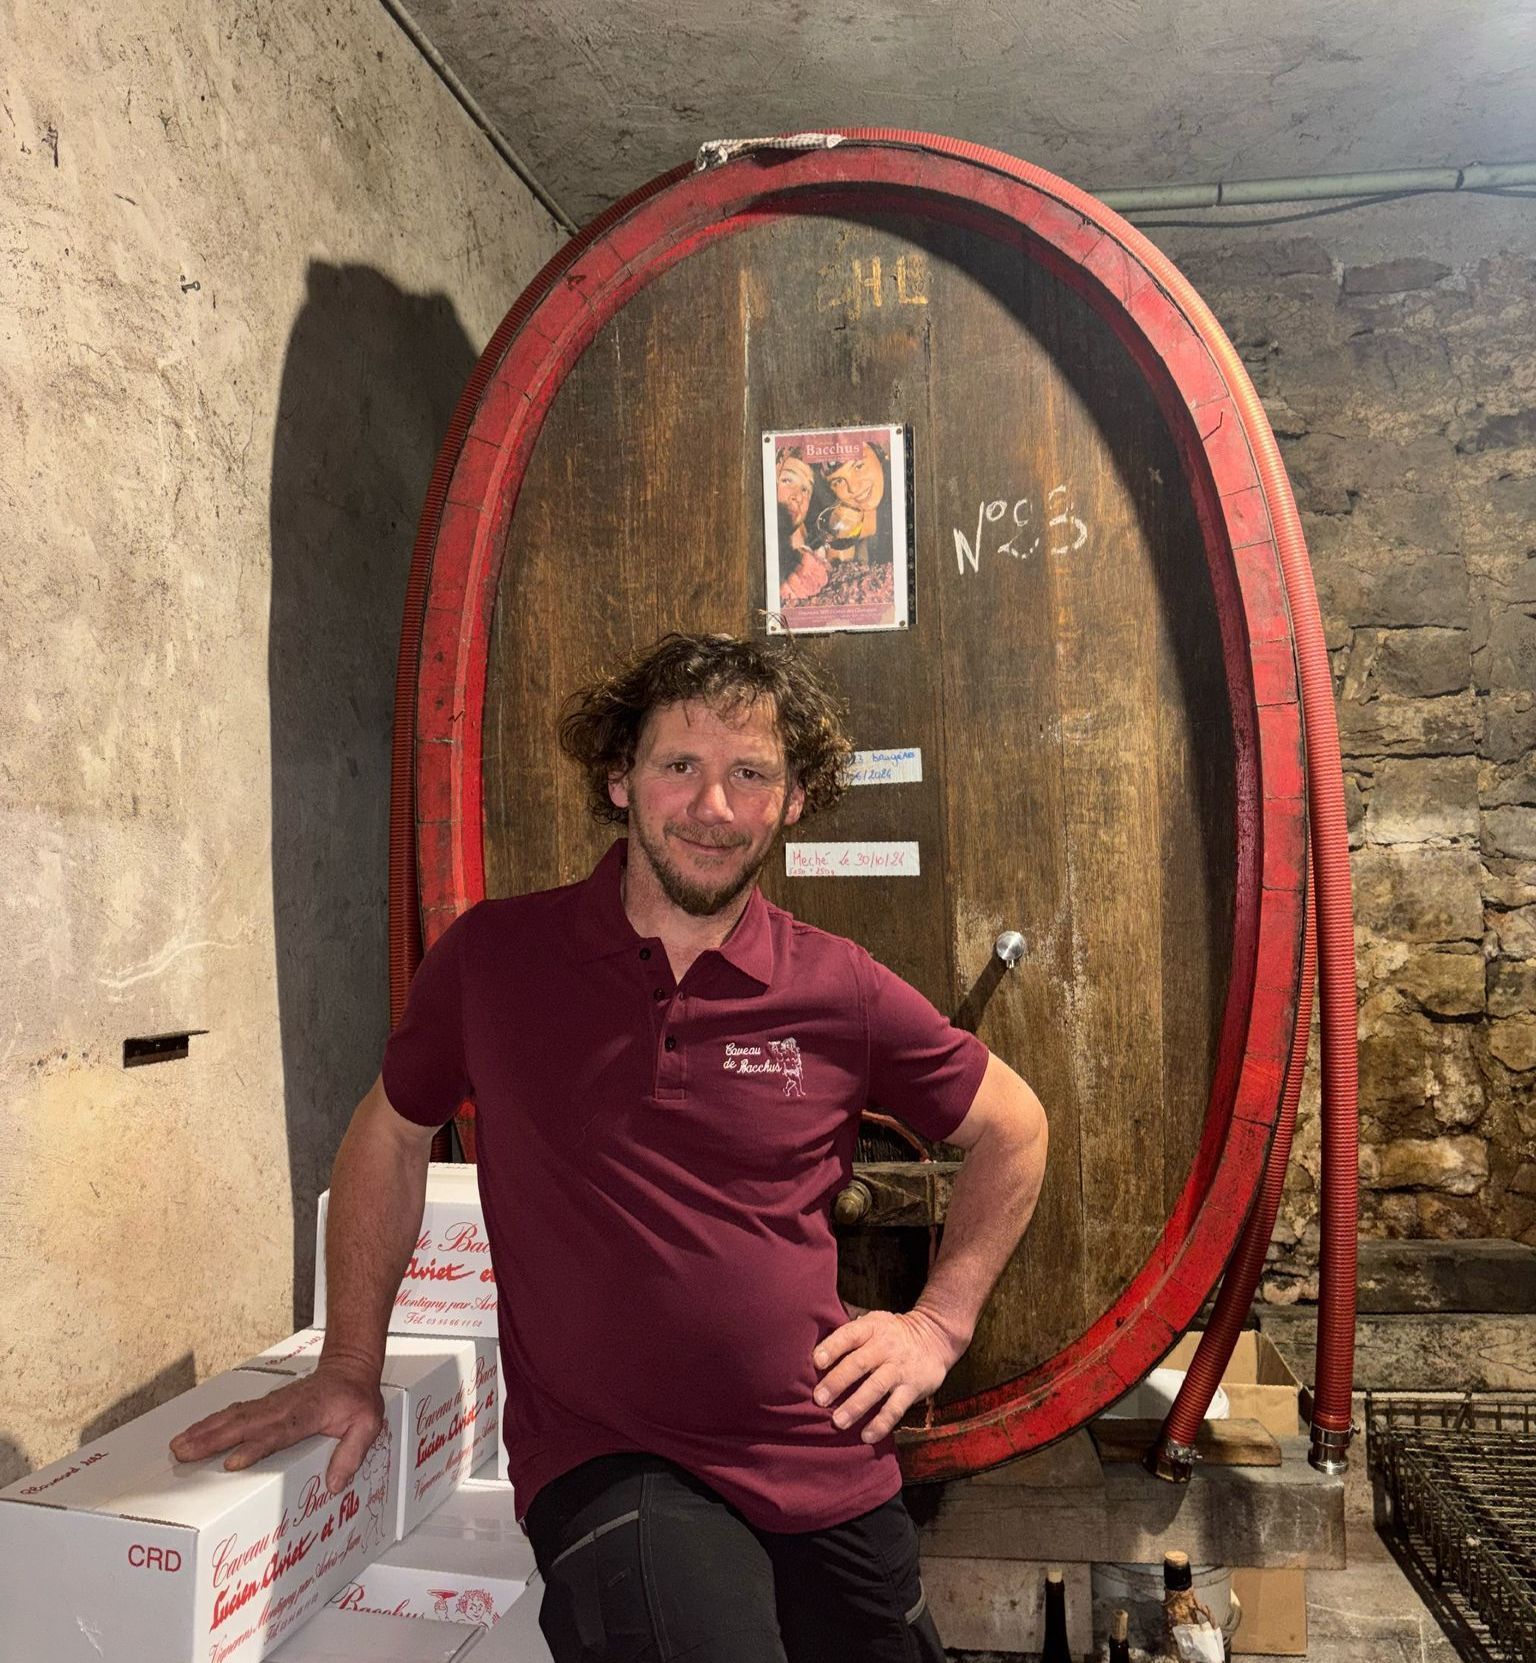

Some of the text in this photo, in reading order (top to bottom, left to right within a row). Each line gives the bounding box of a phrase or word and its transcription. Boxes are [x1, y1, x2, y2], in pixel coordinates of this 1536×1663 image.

[806, 442, 860, 456] Bacchus
[725, 1042, 761, 1056] Caveau
[723, 1058, 783, 1074] de Bacchus
[127, 1544, 182, 1573] CRD
[212, 1532, 270, 1588] Caveau
[271, 1508, 290, 1543] de
[209, 1580, 261, 1634] Lucien
[261, 1530, 319, 1590] Aviet
[321, 1513, 335, 1542] et
[338, 1489, 360, 1529] Fils
